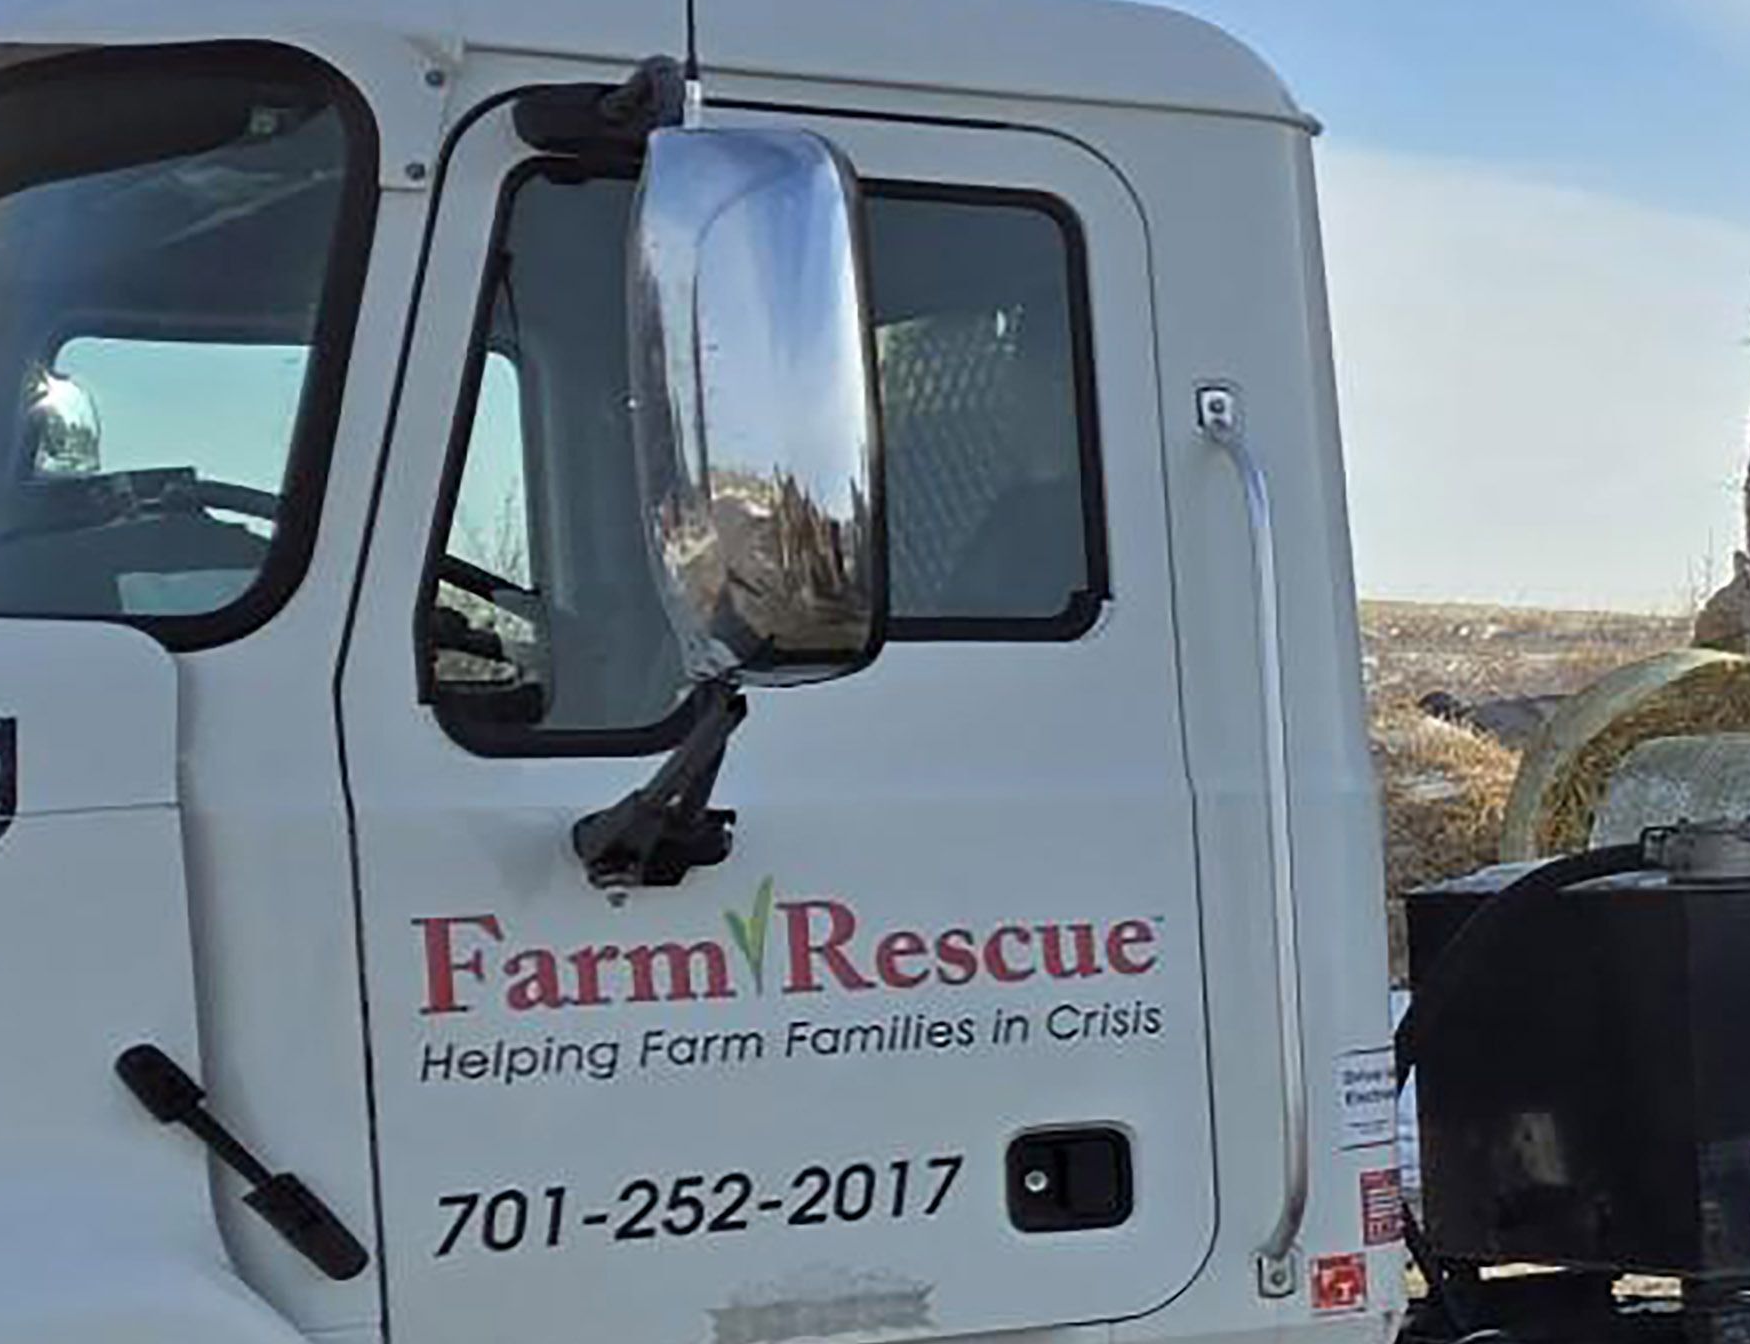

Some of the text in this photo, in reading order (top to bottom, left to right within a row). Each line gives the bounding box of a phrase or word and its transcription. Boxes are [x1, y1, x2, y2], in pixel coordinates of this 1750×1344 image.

[411, 899, 1158, 1016] Farm Rescue
[420, 1000, 1164, 1085] Helping Farm Families in Crisis
[432, 1155, 965, 1259] 701-252-2017
